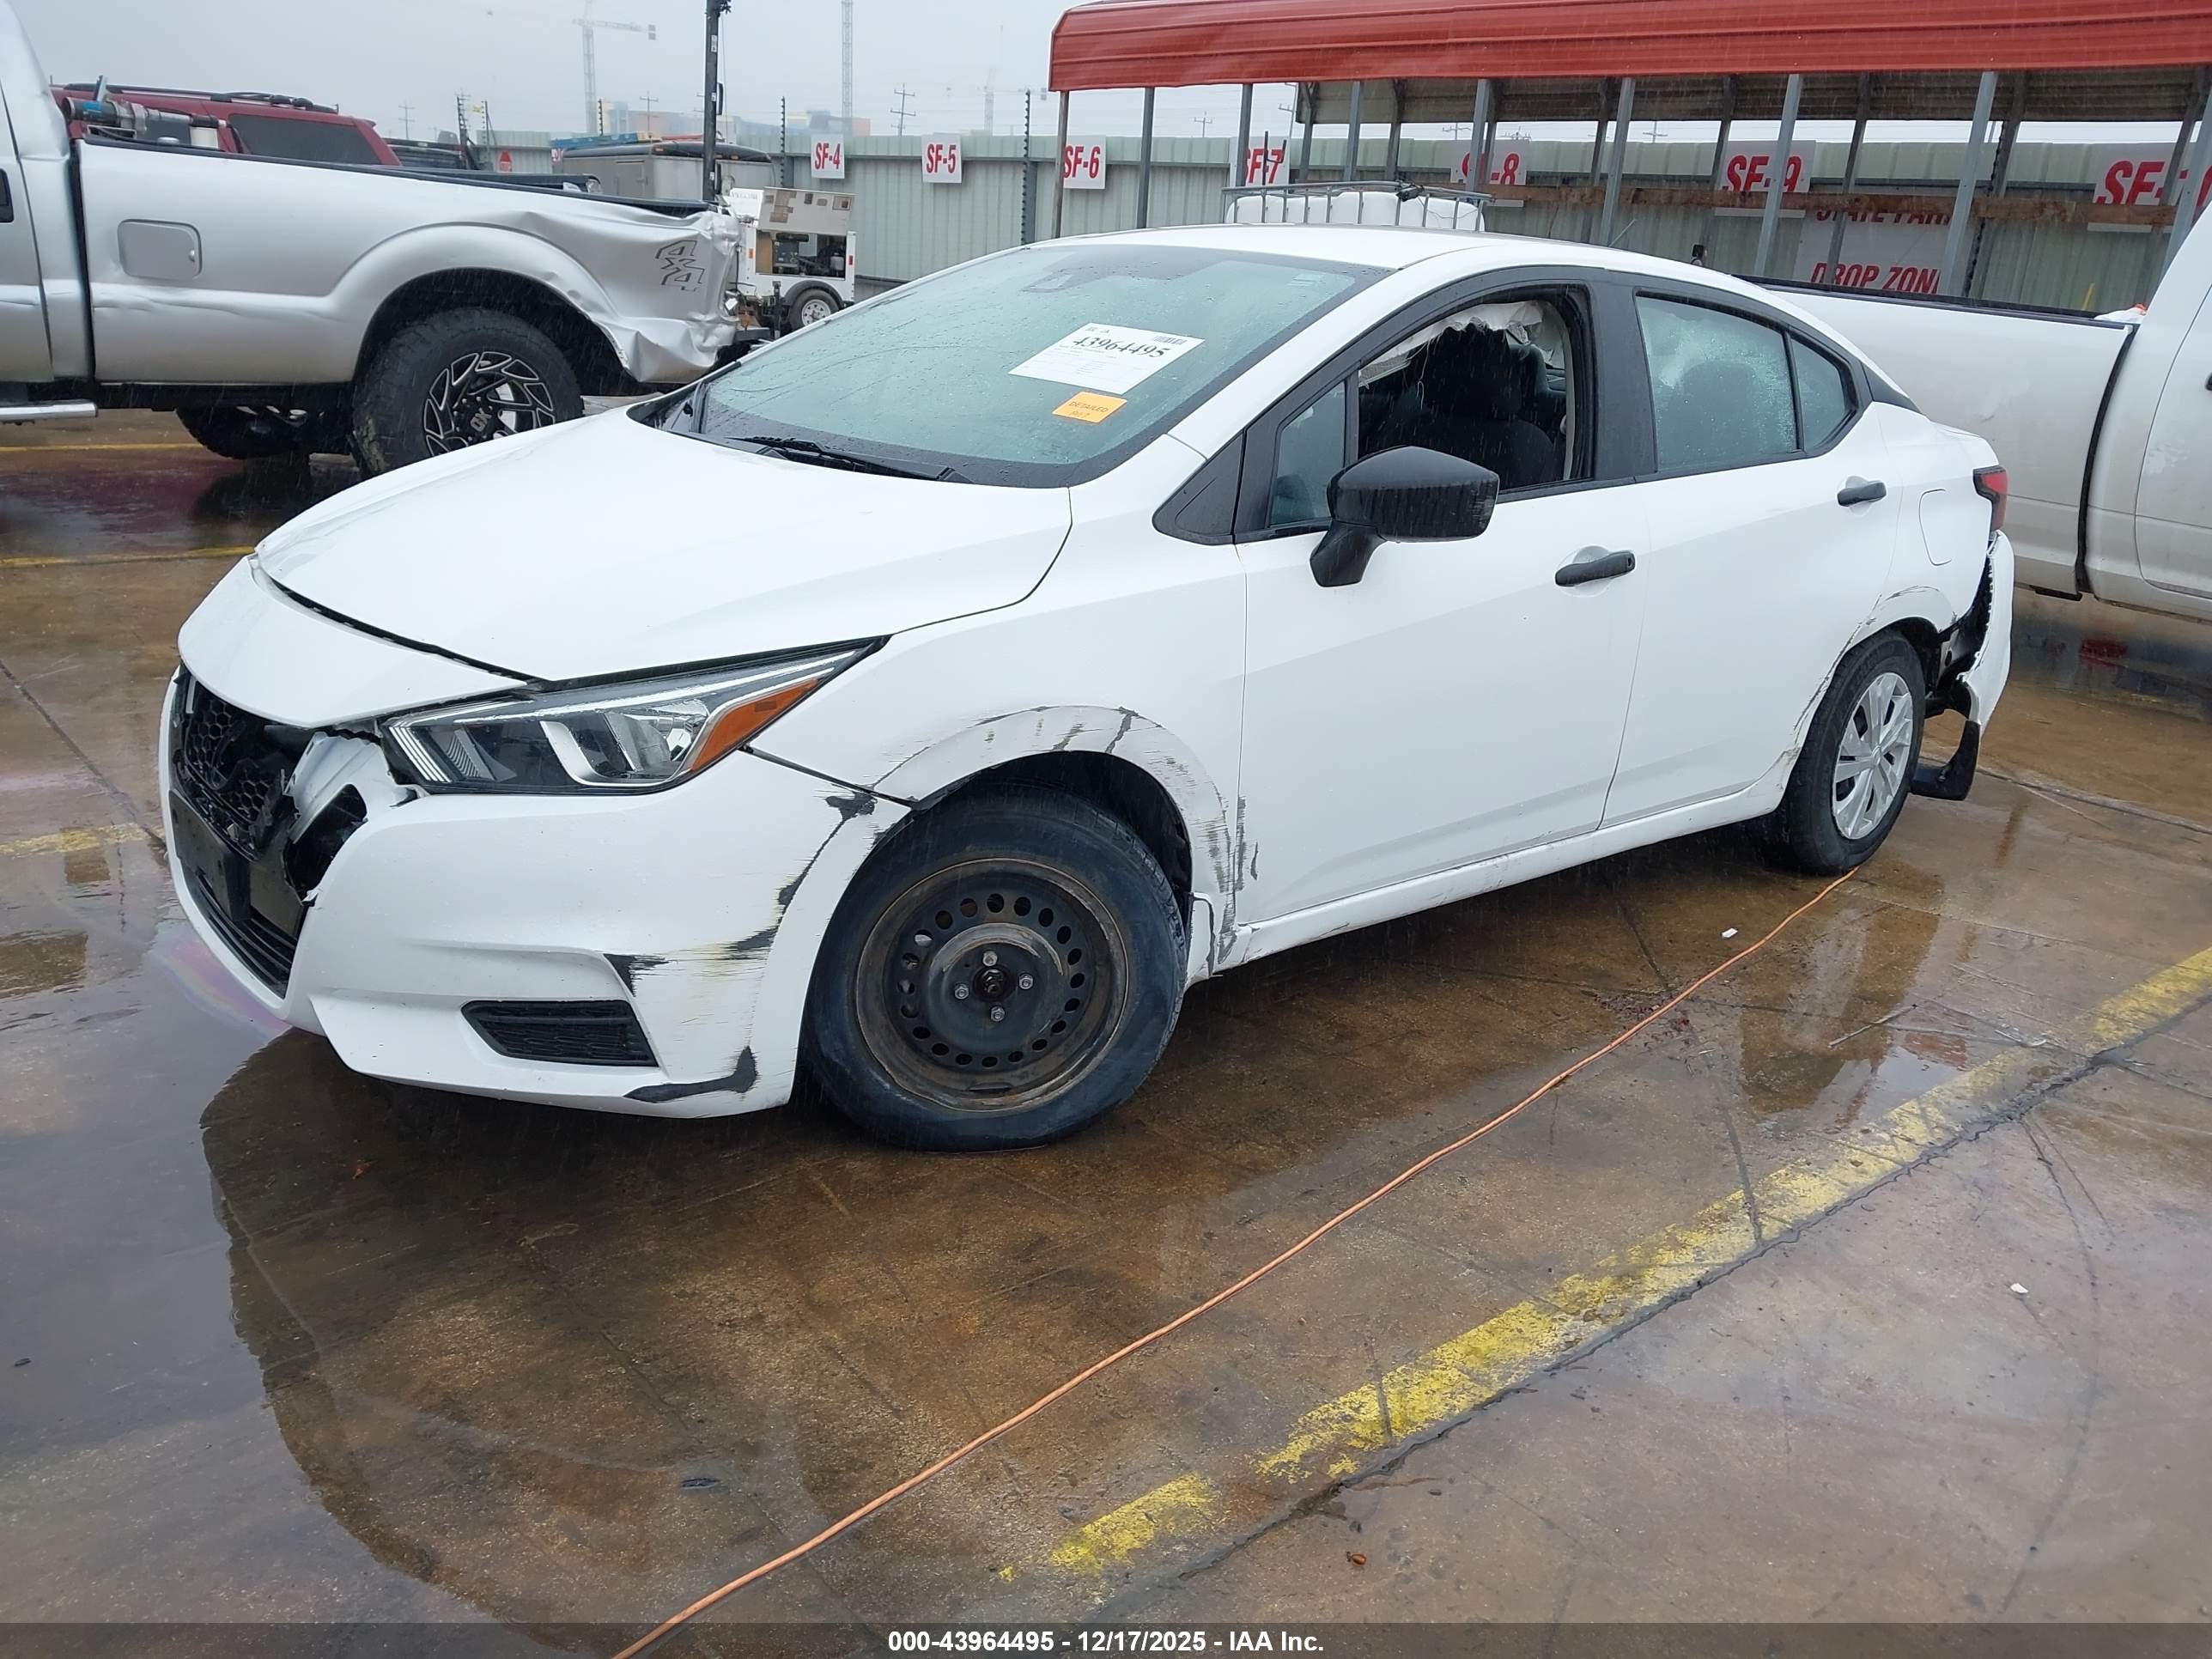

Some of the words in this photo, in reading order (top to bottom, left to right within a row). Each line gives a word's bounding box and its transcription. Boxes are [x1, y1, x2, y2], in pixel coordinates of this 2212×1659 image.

[815, 143, 841, 170] SF-4
[927, 144, 957, 173] SF-5
[1064, 145, 1101, 179] SF-6
[1882, 266, 1942, 294] ZON
[1073, 336, 1171, 358] 43964495
[1068, 401, 1109, 413] DETAILED
